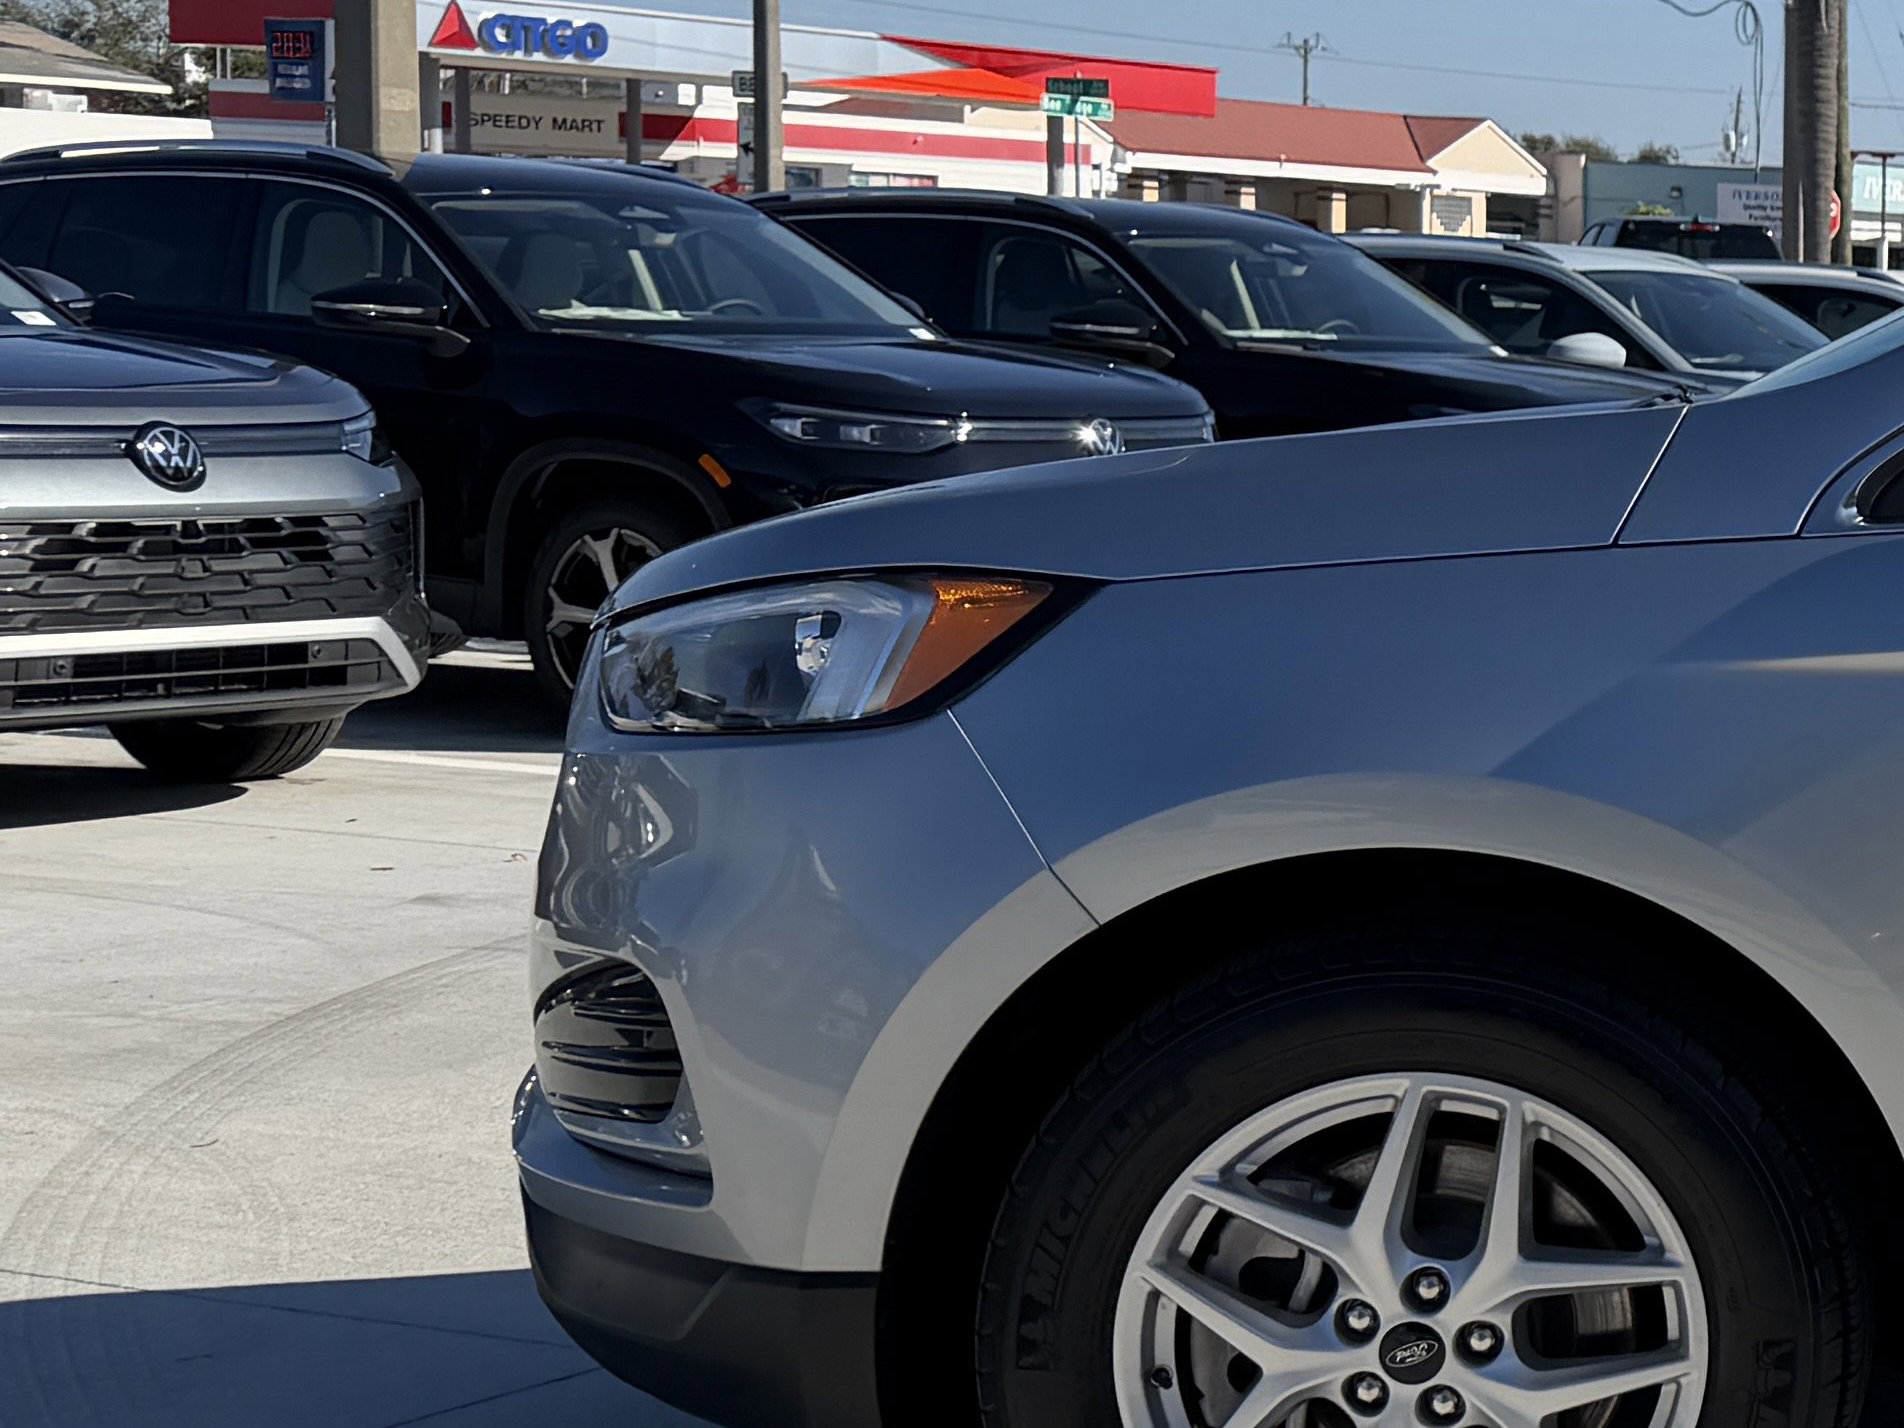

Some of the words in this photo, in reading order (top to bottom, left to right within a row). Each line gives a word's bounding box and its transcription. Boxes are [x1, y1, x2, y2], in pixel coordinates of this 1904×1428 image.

[478, 13, 609, 63] CITGO
[470, 113, 544, 132] SPEEDY
[552, 116, 606, 134] MART
[1021, 1065, 1196, 1306] MICHELIN
